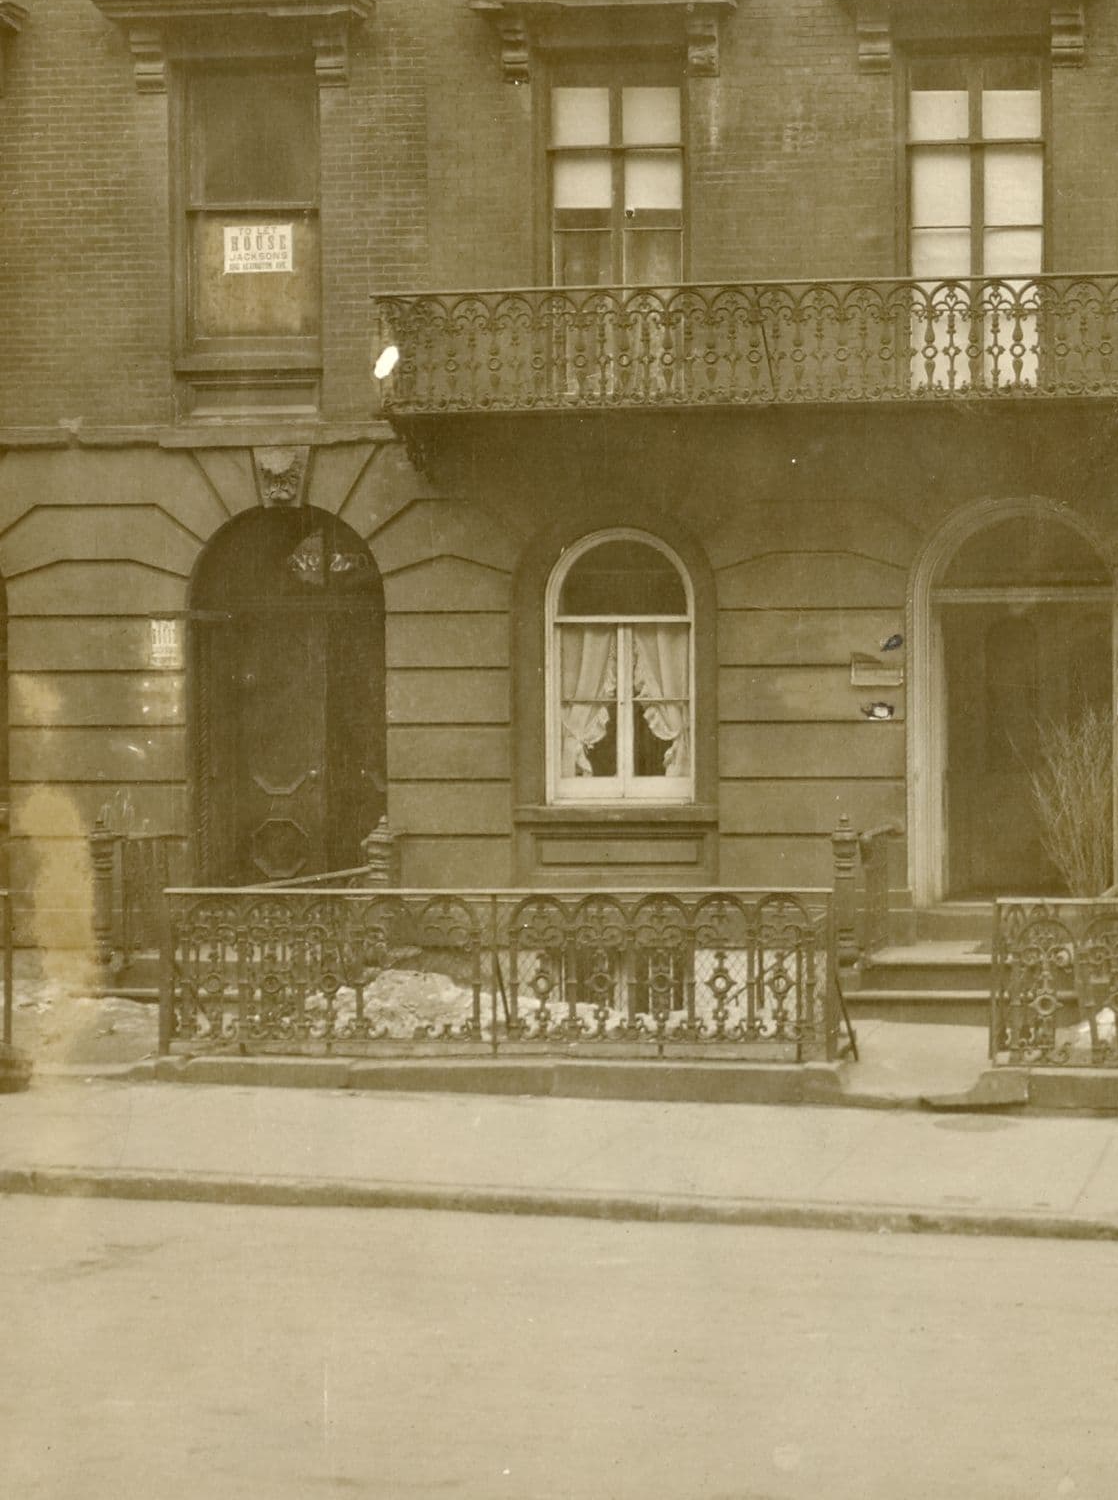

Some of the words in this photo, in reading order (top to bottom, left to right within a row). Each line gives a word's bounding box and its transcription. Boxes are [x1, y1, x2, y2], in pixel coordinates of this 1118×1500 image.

[238, 227, 252, 236] TO
[256, 226, 278, 235] LET
[230, 234, 287, 252] HOUSE
